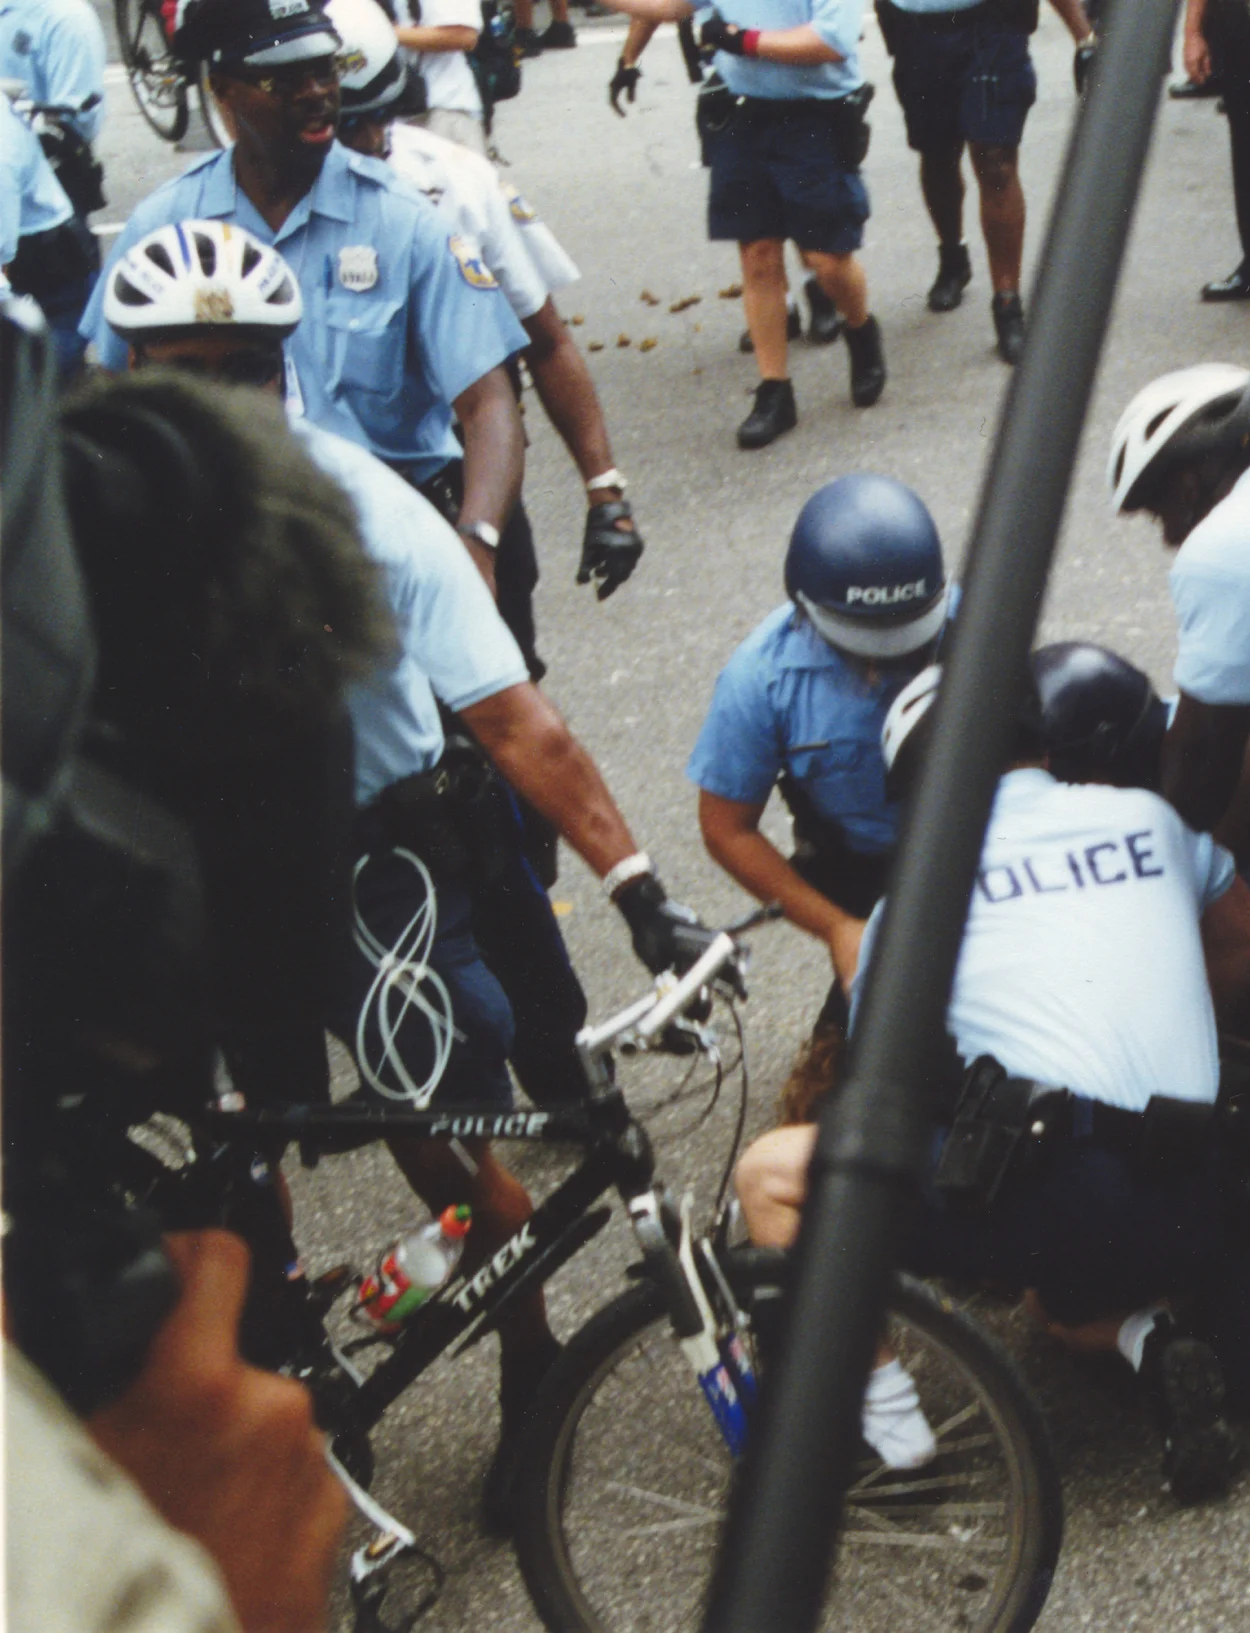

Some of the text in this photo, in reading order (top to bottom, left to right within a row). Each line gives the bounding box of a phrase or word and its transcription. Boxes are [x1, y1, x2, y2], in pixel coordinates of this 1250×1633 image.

[846, 578, 927, 605] POLICE
[978, 830, 1166, 904] OLICE
[452, 1221, 537, 1313] TREK
